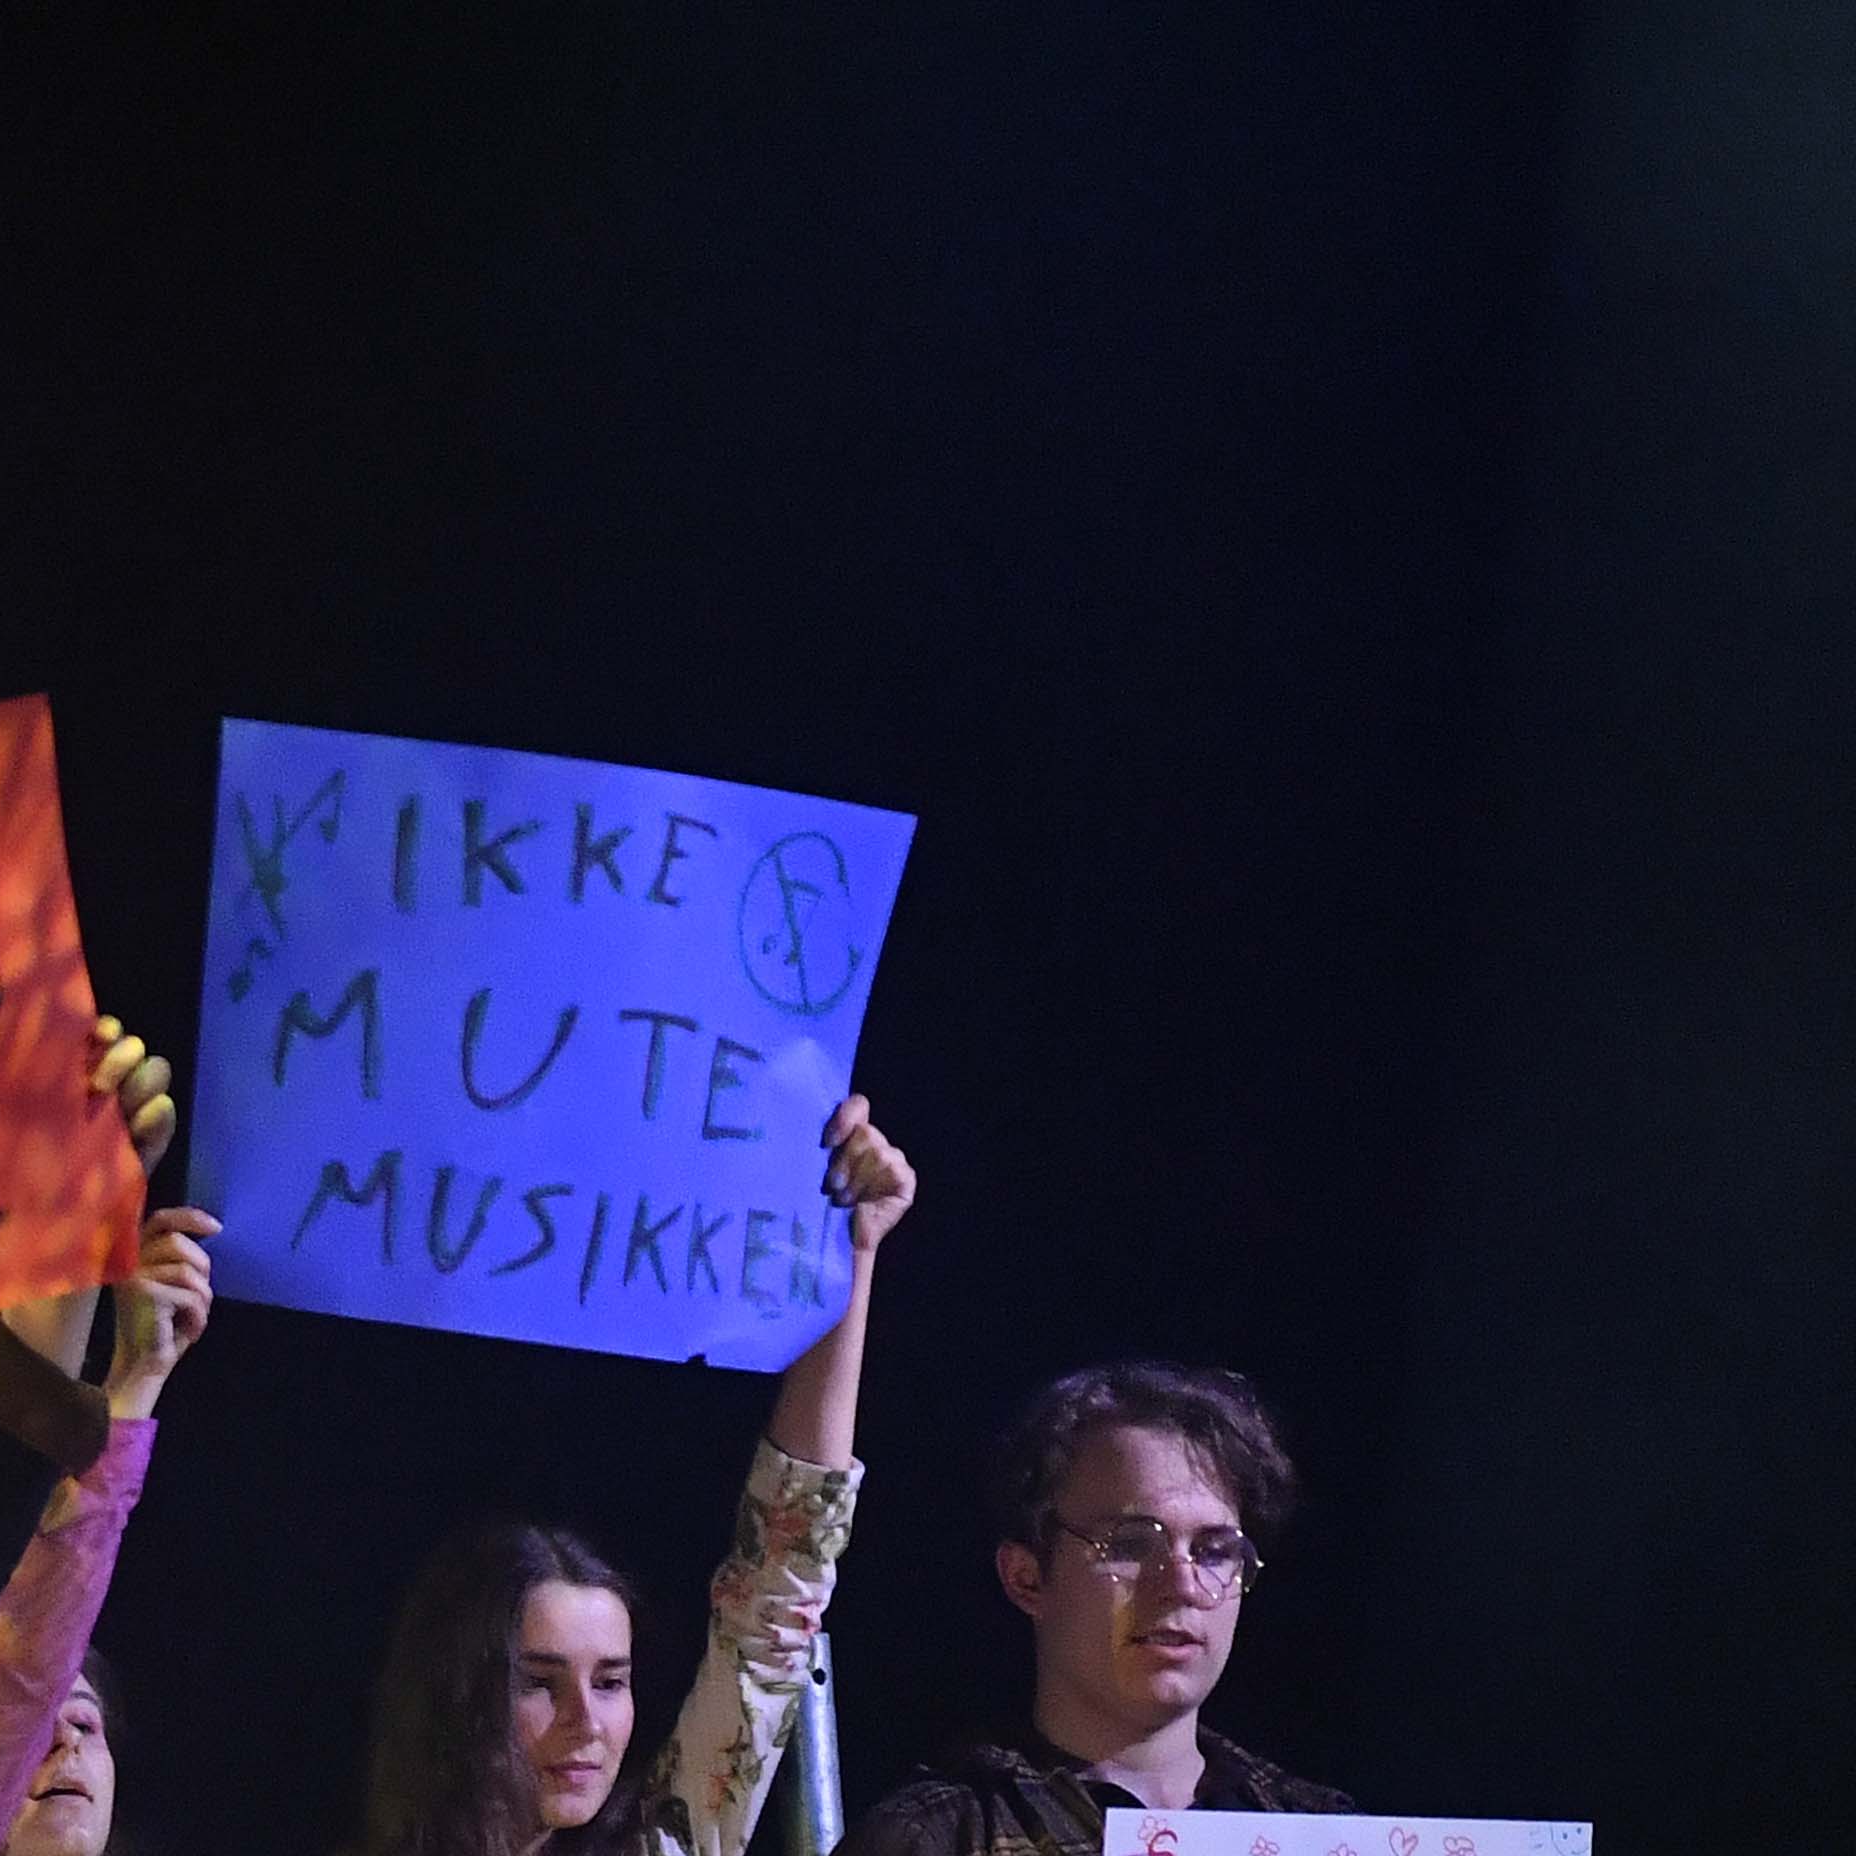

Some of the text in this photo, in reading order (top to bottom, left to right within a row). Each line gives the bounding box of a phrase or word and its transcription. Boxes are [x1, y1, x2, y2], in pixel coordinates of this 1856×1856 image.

[392, 794, 719, 913] IKKE
[271, 968, 767, 1142] MUTE
[288, 1148, 834, 1310] MUSIKKEN
